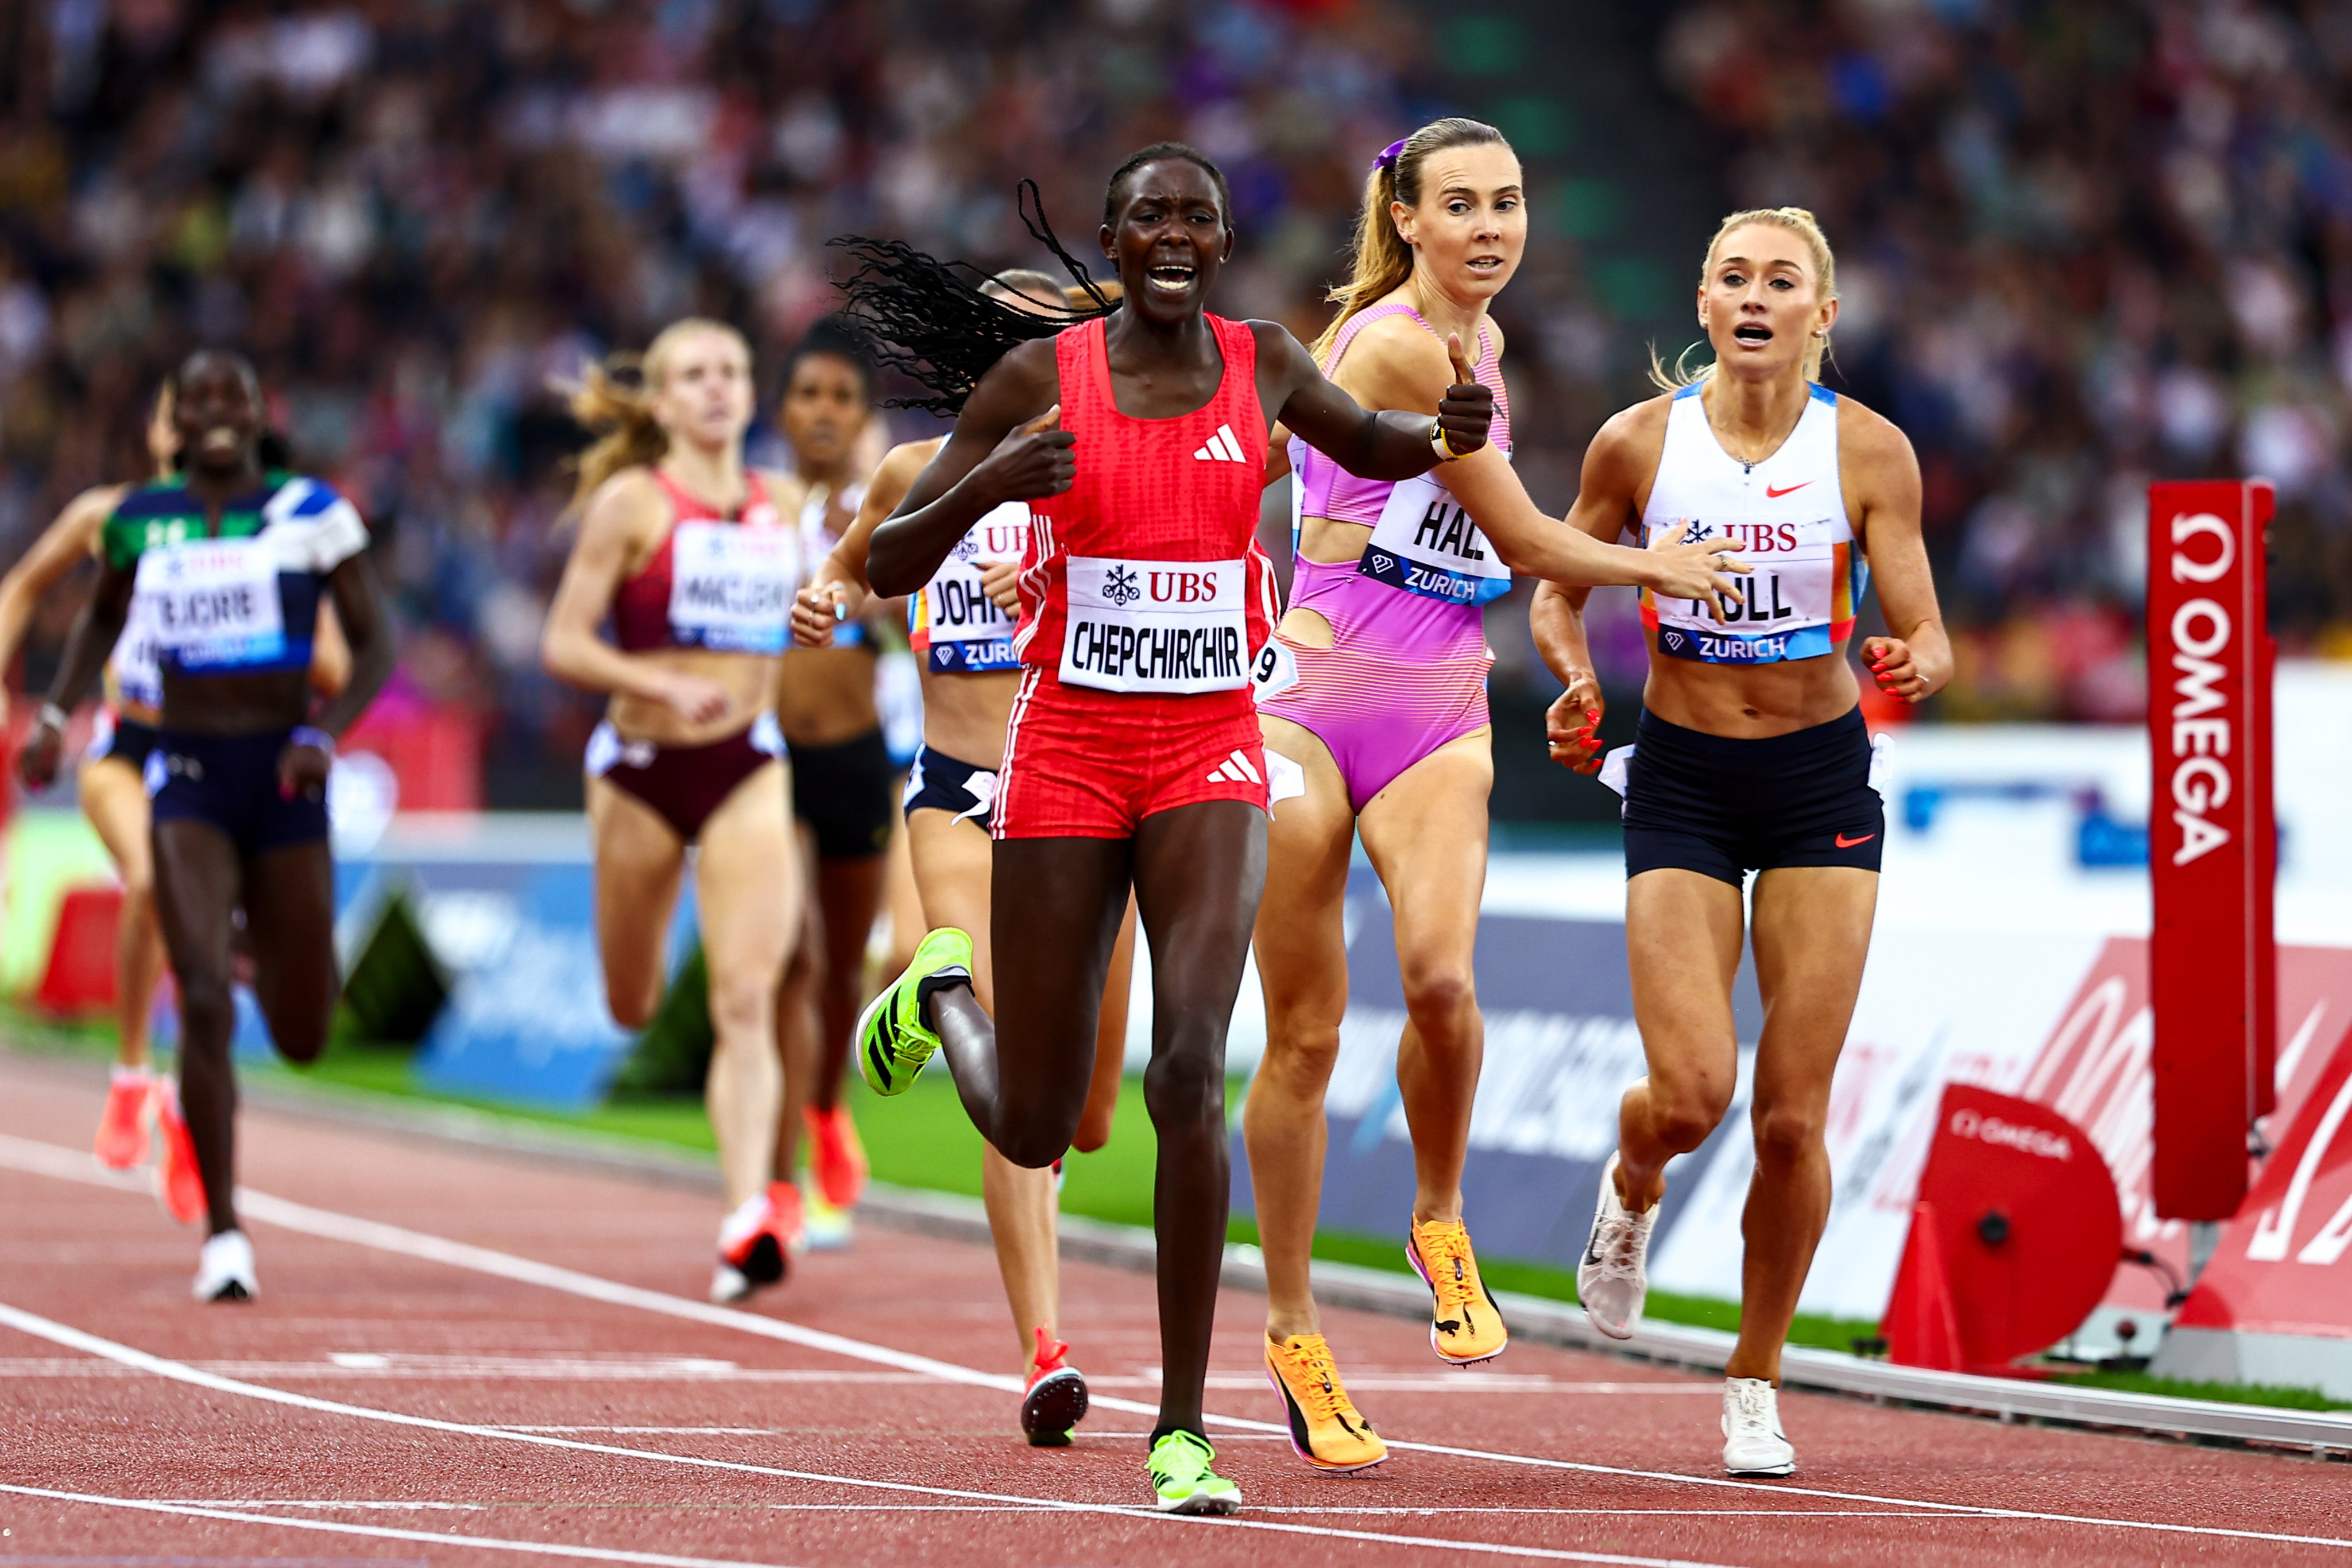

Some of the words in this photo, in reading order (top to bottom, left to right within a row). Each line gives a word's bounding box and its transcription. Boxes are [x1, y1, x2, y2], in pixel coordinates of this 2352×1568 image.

[1413, 501, 1484, 561] HAL
[1722, 523, 1797, 552] UBS
[1148, 572, 1217, 602] UBS
[1404, 567, 1476, 600] ZURICH
[1072, 622, 1240, 679] CHEPCHIRCHIR
[1256, 647, 1276, 683] 9
[1699, 637, 1786, 658] ZURICH
[2171, 598, 2231, 866] OMEGA
[1979, 1117, 2073, 1162] OMEGA
